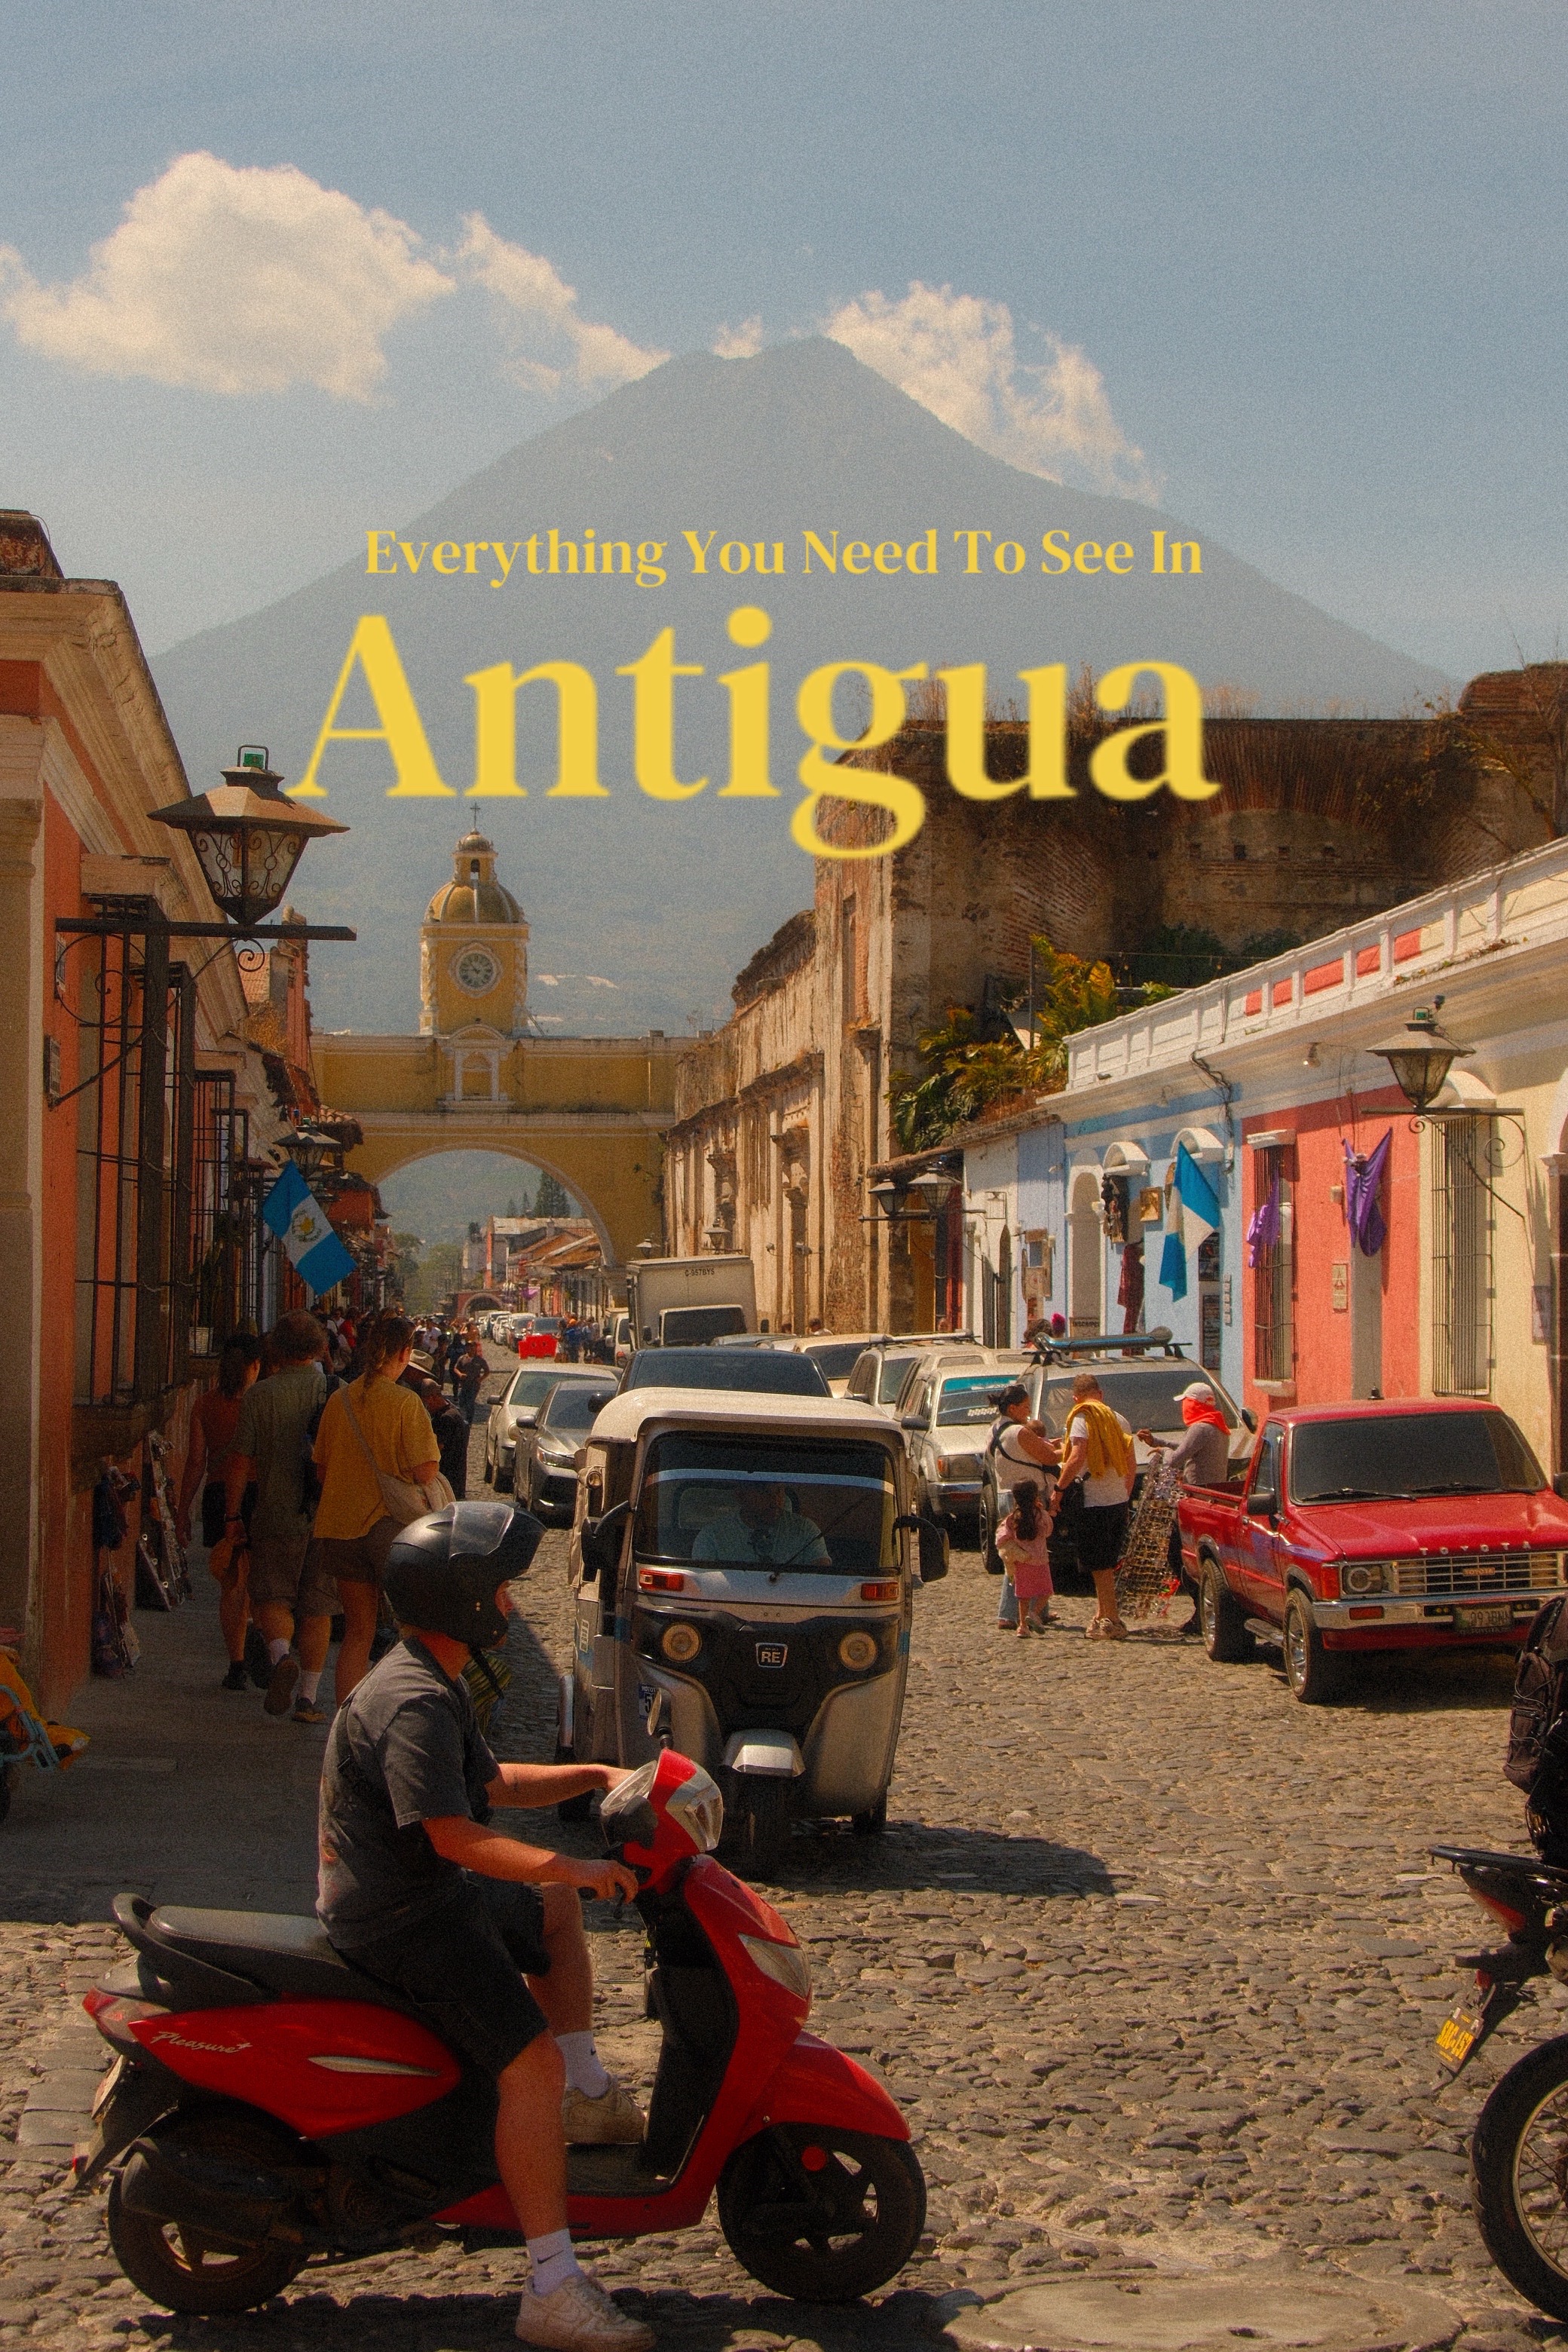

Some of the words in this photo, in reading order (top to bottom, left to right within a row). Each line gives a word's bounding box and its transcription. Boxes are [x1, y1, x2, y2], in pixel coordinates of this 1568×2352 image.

[1419, 1541, 1531, 1556] TOYOTA
[1464, 1568, 1494, 1576] TOYOTA
[761, 1651, 781, 1663] RE
